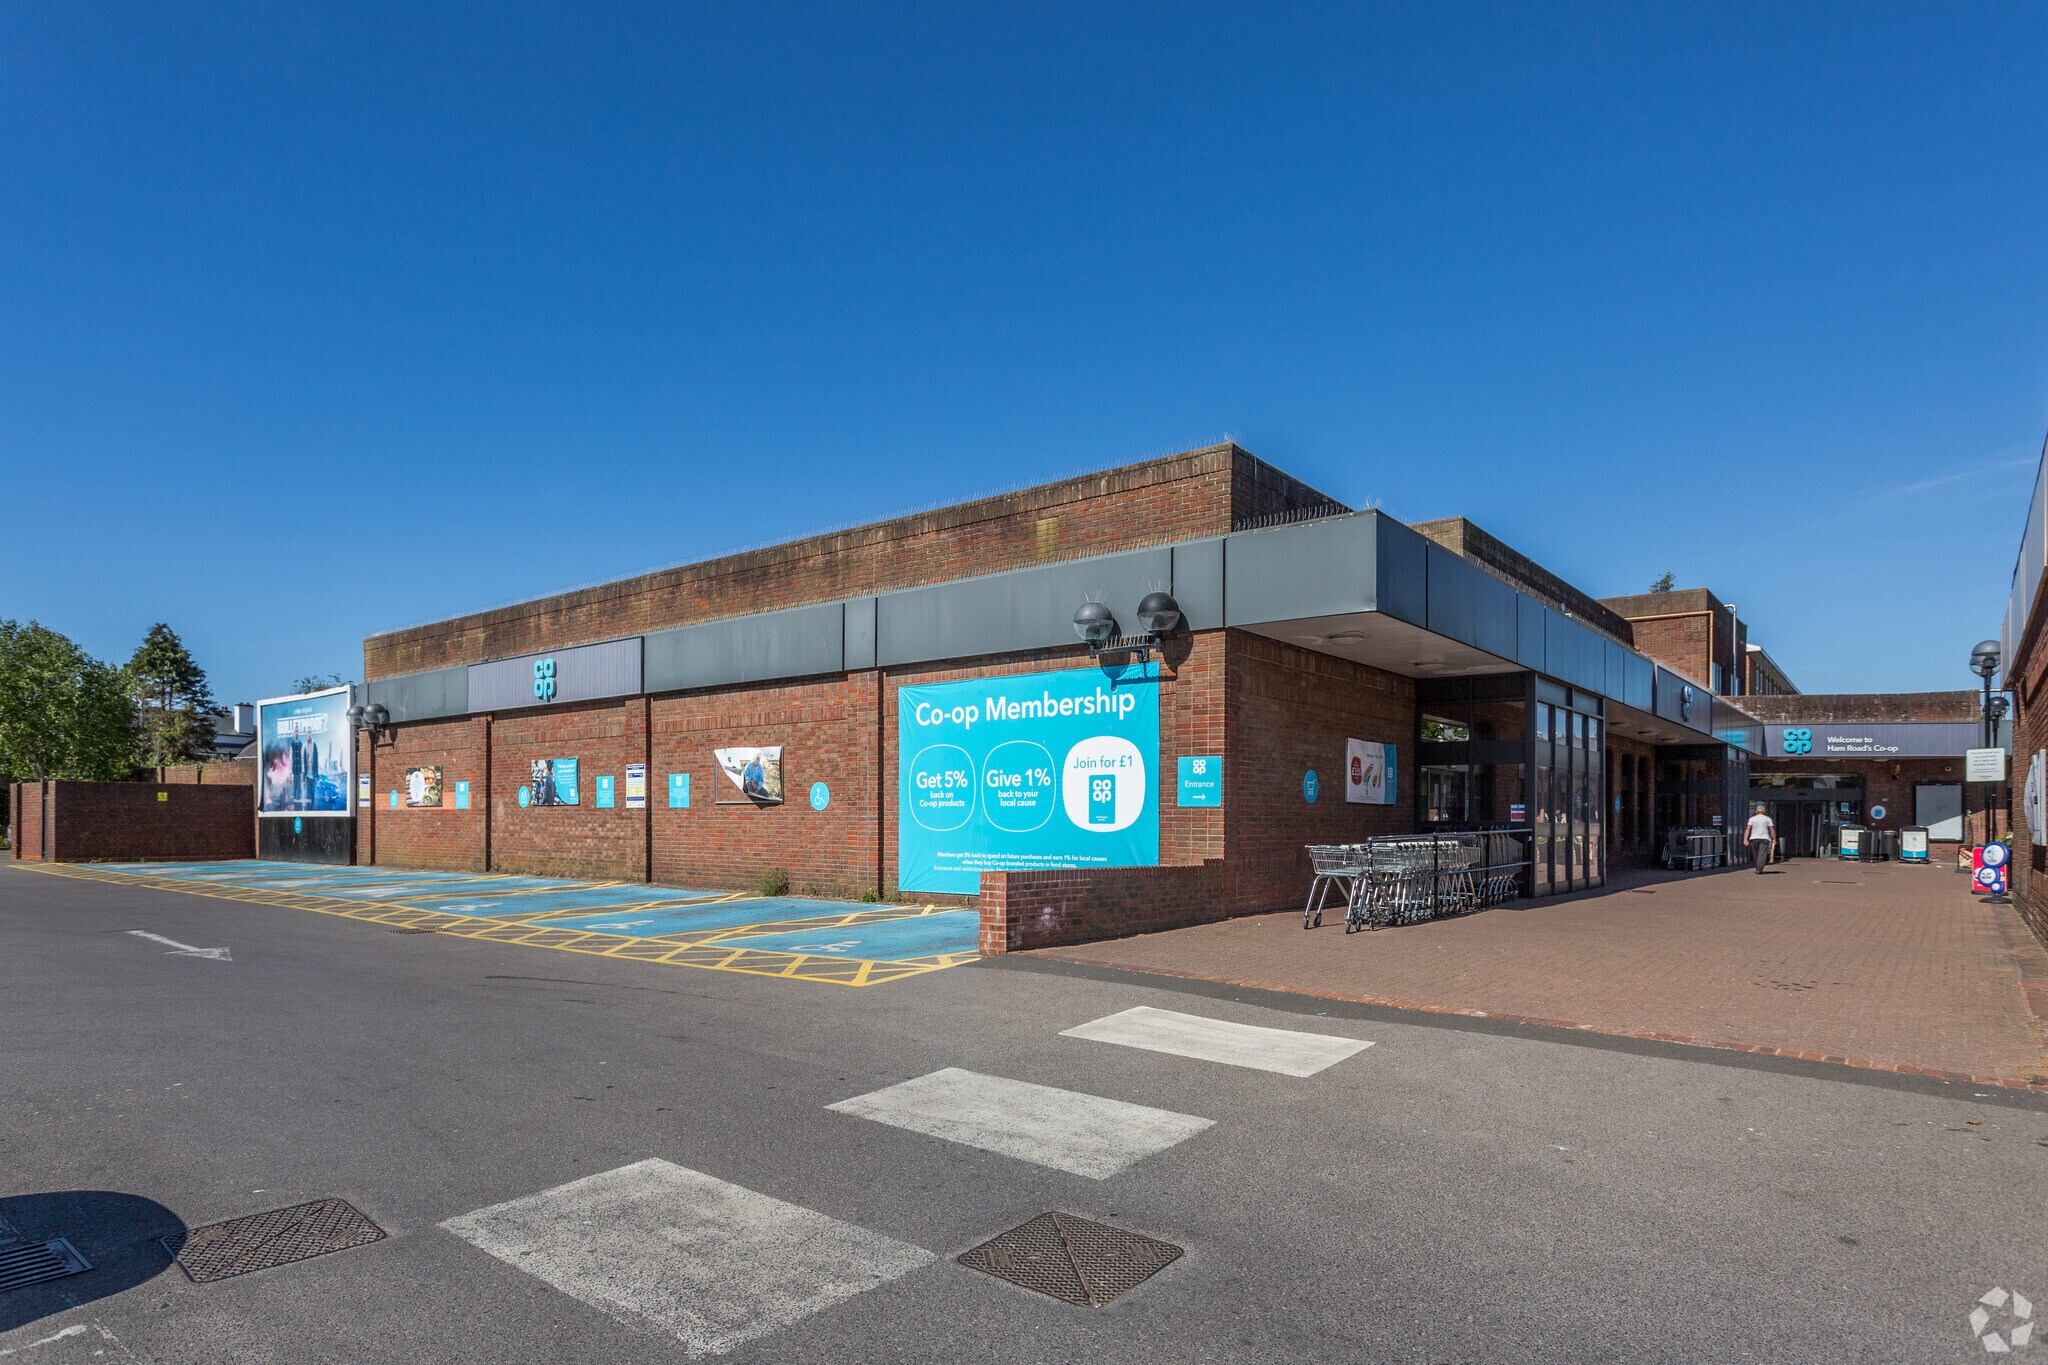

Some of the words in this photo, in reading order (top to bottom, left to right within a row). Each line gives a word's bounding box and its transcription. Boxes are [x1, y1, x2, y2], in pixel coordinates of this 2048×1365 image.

[916, 702, 978, 730] Co-op
[986, 686, 1136, 721] Membership
[1874, 745, 1898, 753] Co-op
[1073, 756, 1096, 769] Join
[1100, 756, 1116, 768] for
[1119, 755, 1133, 768] £1
[916, 771, 942, 788] Get
[944, 770, 968, 788] 5%
[986, 769, 1021, 787] Give
[1025, 768, 1051, 786] 1%
[1184, 780, 1214, 788] Entrance
[930, 790, 943, 798] back
[998, 790, 1013, 798] back
[1023, 791, 1039, 800] your
[919, 799, 937, 808] Co-op
[938, 799, 965, 808] products
[1000, 799, 1015, 807] local
